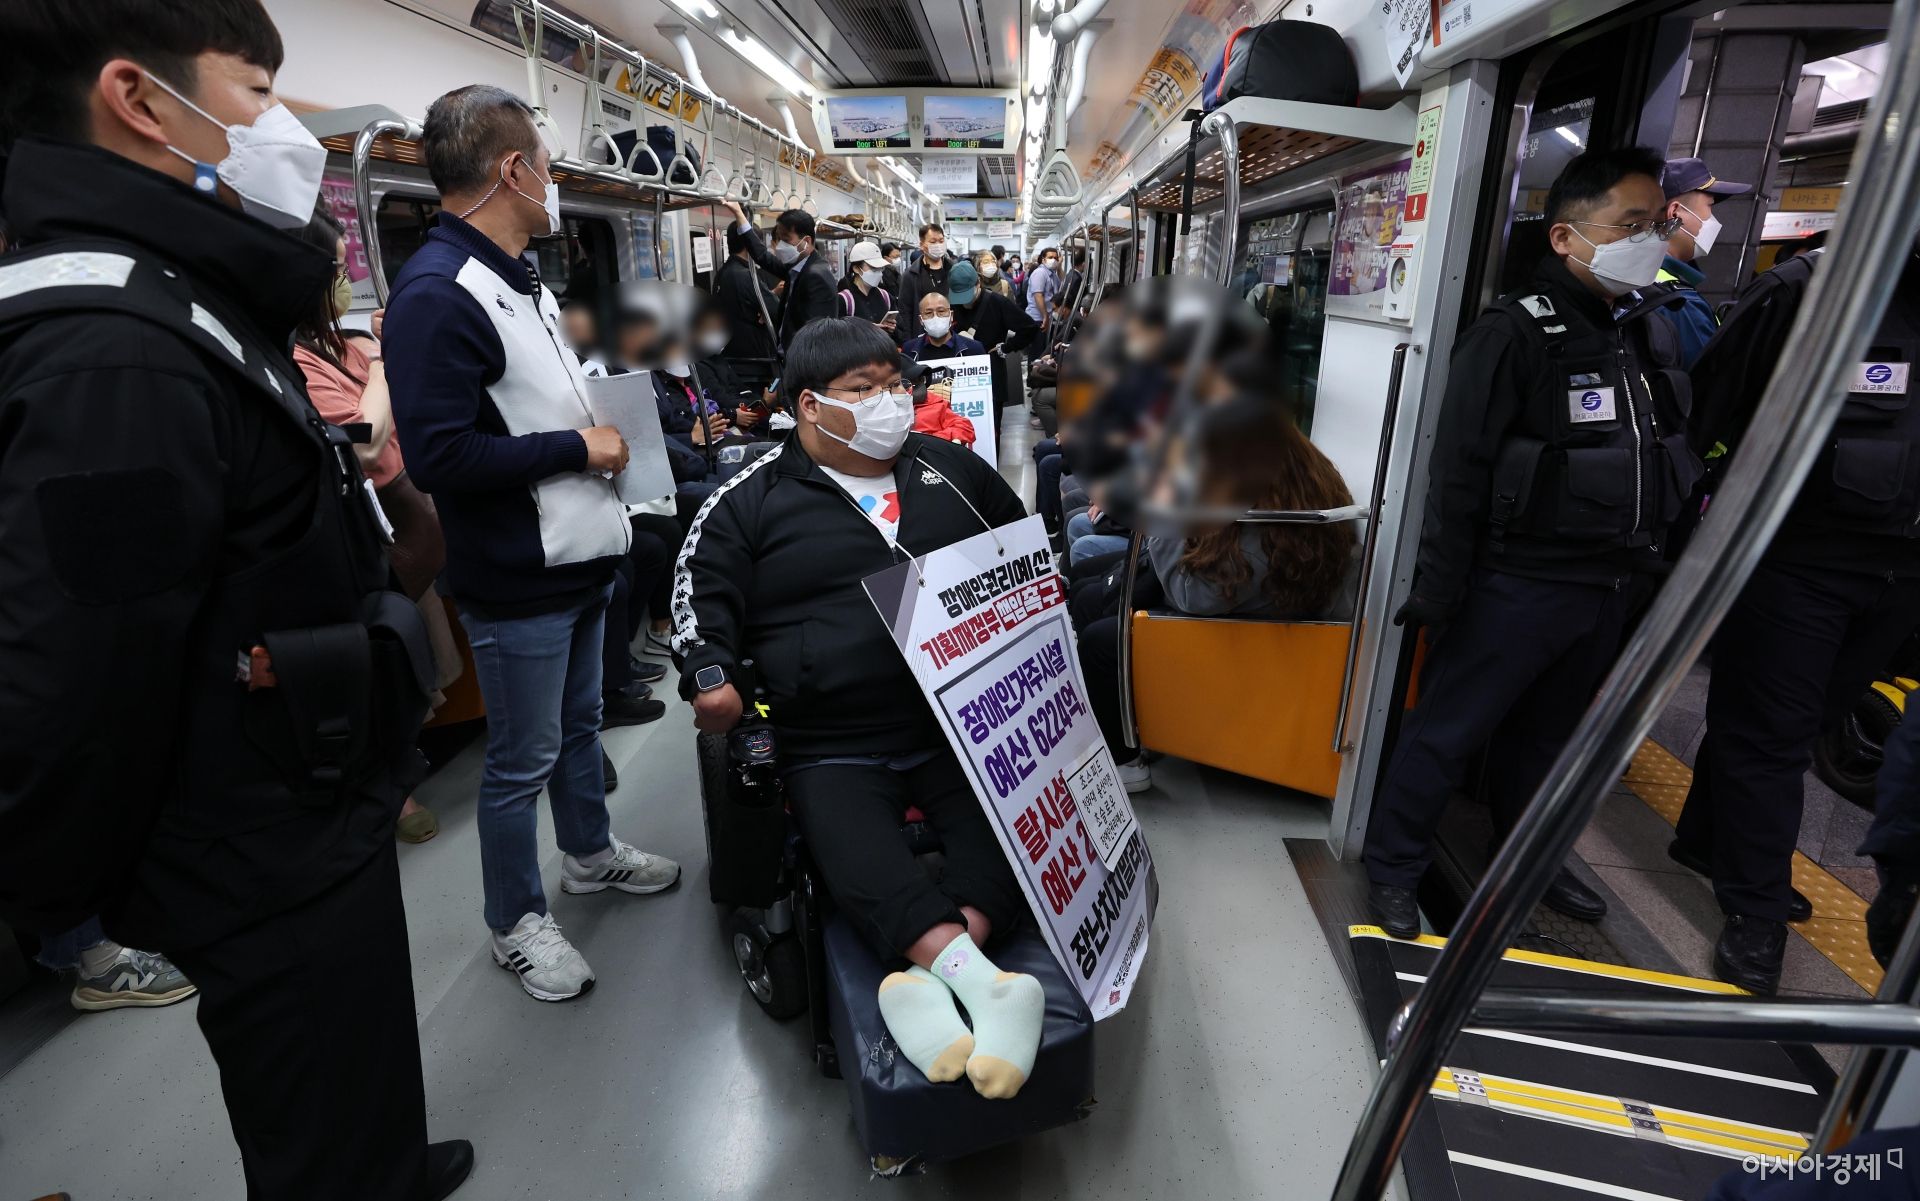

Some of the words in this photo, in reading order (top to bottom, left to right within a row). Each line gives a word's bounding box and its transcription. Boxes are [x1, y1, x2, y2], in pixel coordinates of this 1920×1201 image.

[856, 140, 871, 148] Door
[875, 140, 888, 148] LEFT
[947, 140, 963, 148] Door
[967, 140, 980, 148] LEFT
[937, 548, 1052, 619] 장애인권리예산
[957, 638, 1068, 745] 장애인거주시설
[984, 728, 1038, 799] 예산
[1013, 768, 1077, 866] 탈시설
[1041, 835, 1087, 916] 예산
